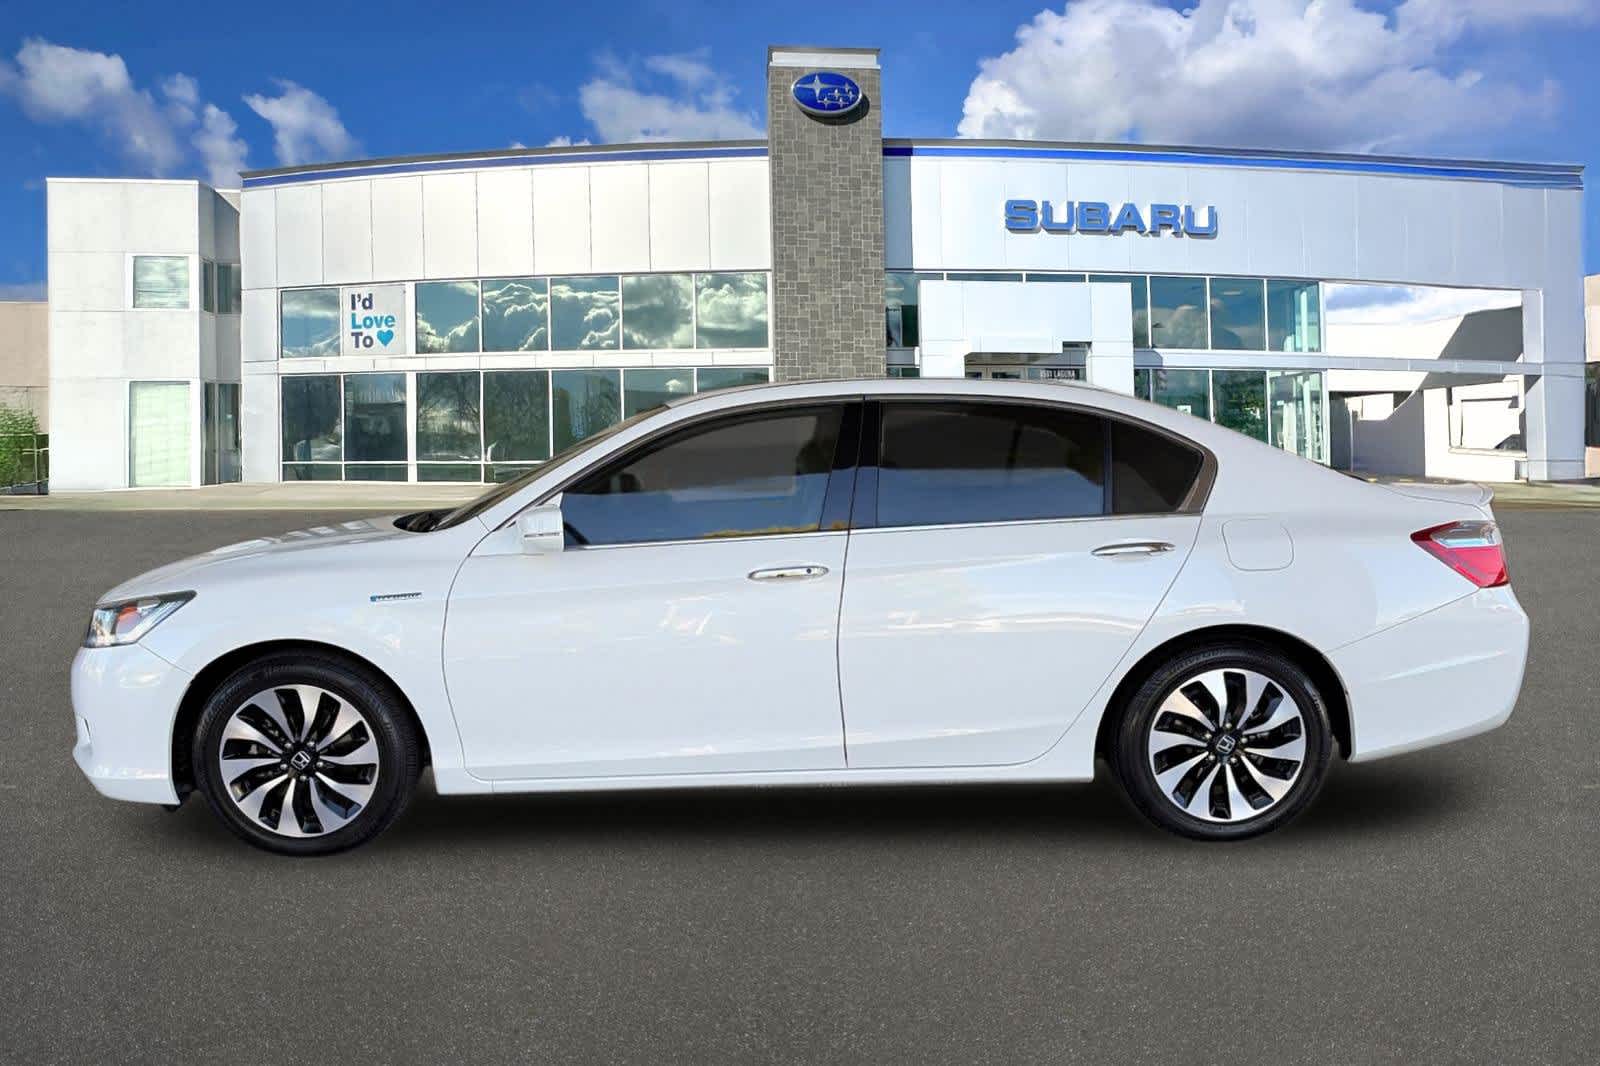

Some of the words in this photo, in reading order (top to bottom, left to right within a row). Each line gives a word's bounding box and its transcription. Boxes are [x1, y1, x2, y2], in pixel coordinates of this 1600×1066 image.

[1005, 199, 1217, 238] SUBARU
[351, 293, 373, 310] I'd
[351, 313, 395, 330] Love
[351, 332, 374, 348] To
